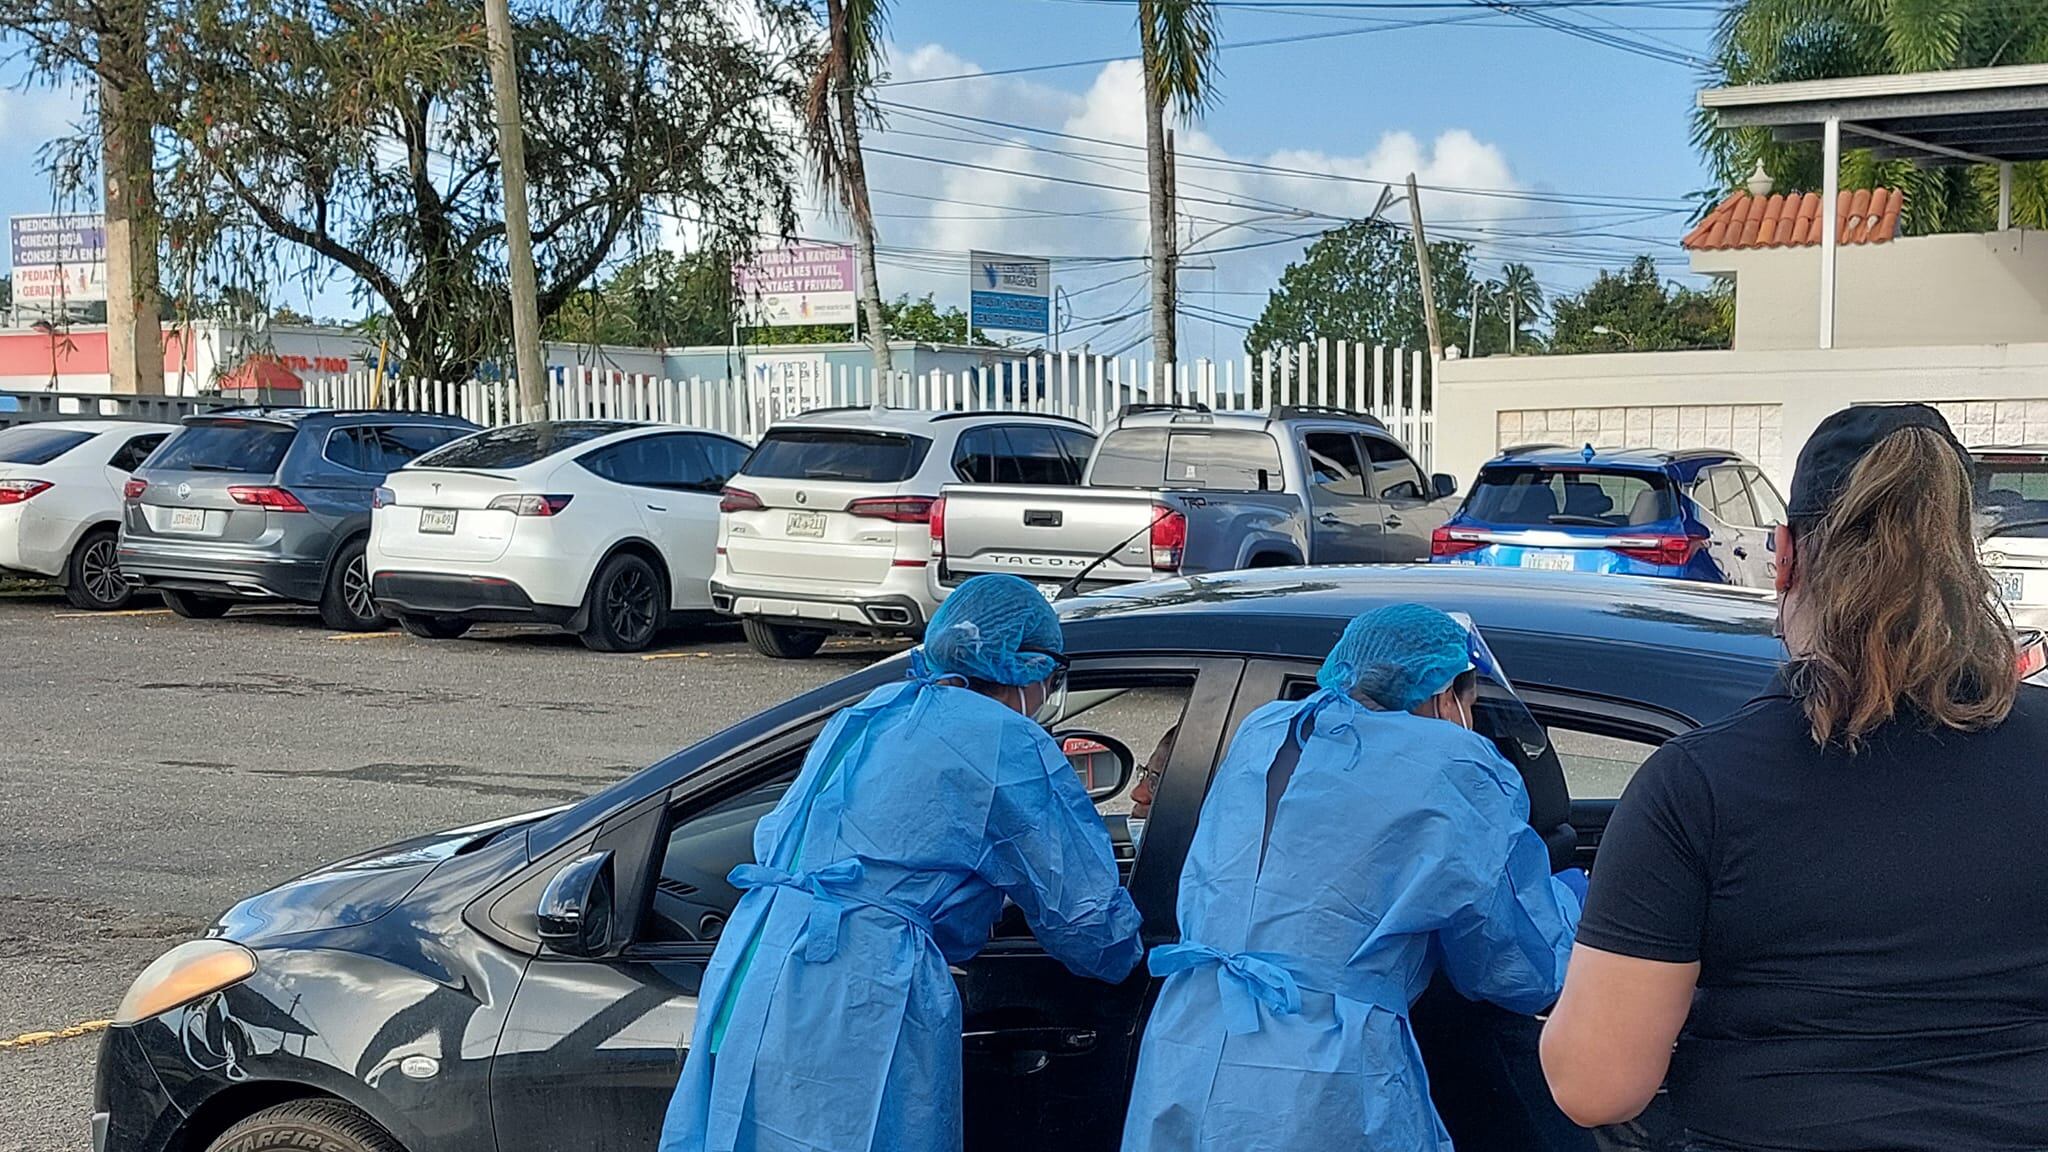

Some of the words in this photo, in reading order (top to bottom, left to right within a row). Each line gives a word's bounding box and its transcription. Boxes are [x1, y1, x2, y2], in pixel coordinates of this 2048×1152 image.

[22, 268, 70, 281] PEDIATRA
[776, 264, 811, 278] PLANES
[23, 284, 72, 297] GERIATRA
[743, 279, 795, 293] ADNTAGE
[797, 279, 804, 291] Y
[804, 278, 844, 291] PRIVADO
[1178, 496, 1206, 510] TRD
[228, 1130, 343, 1152] TARFIRE
